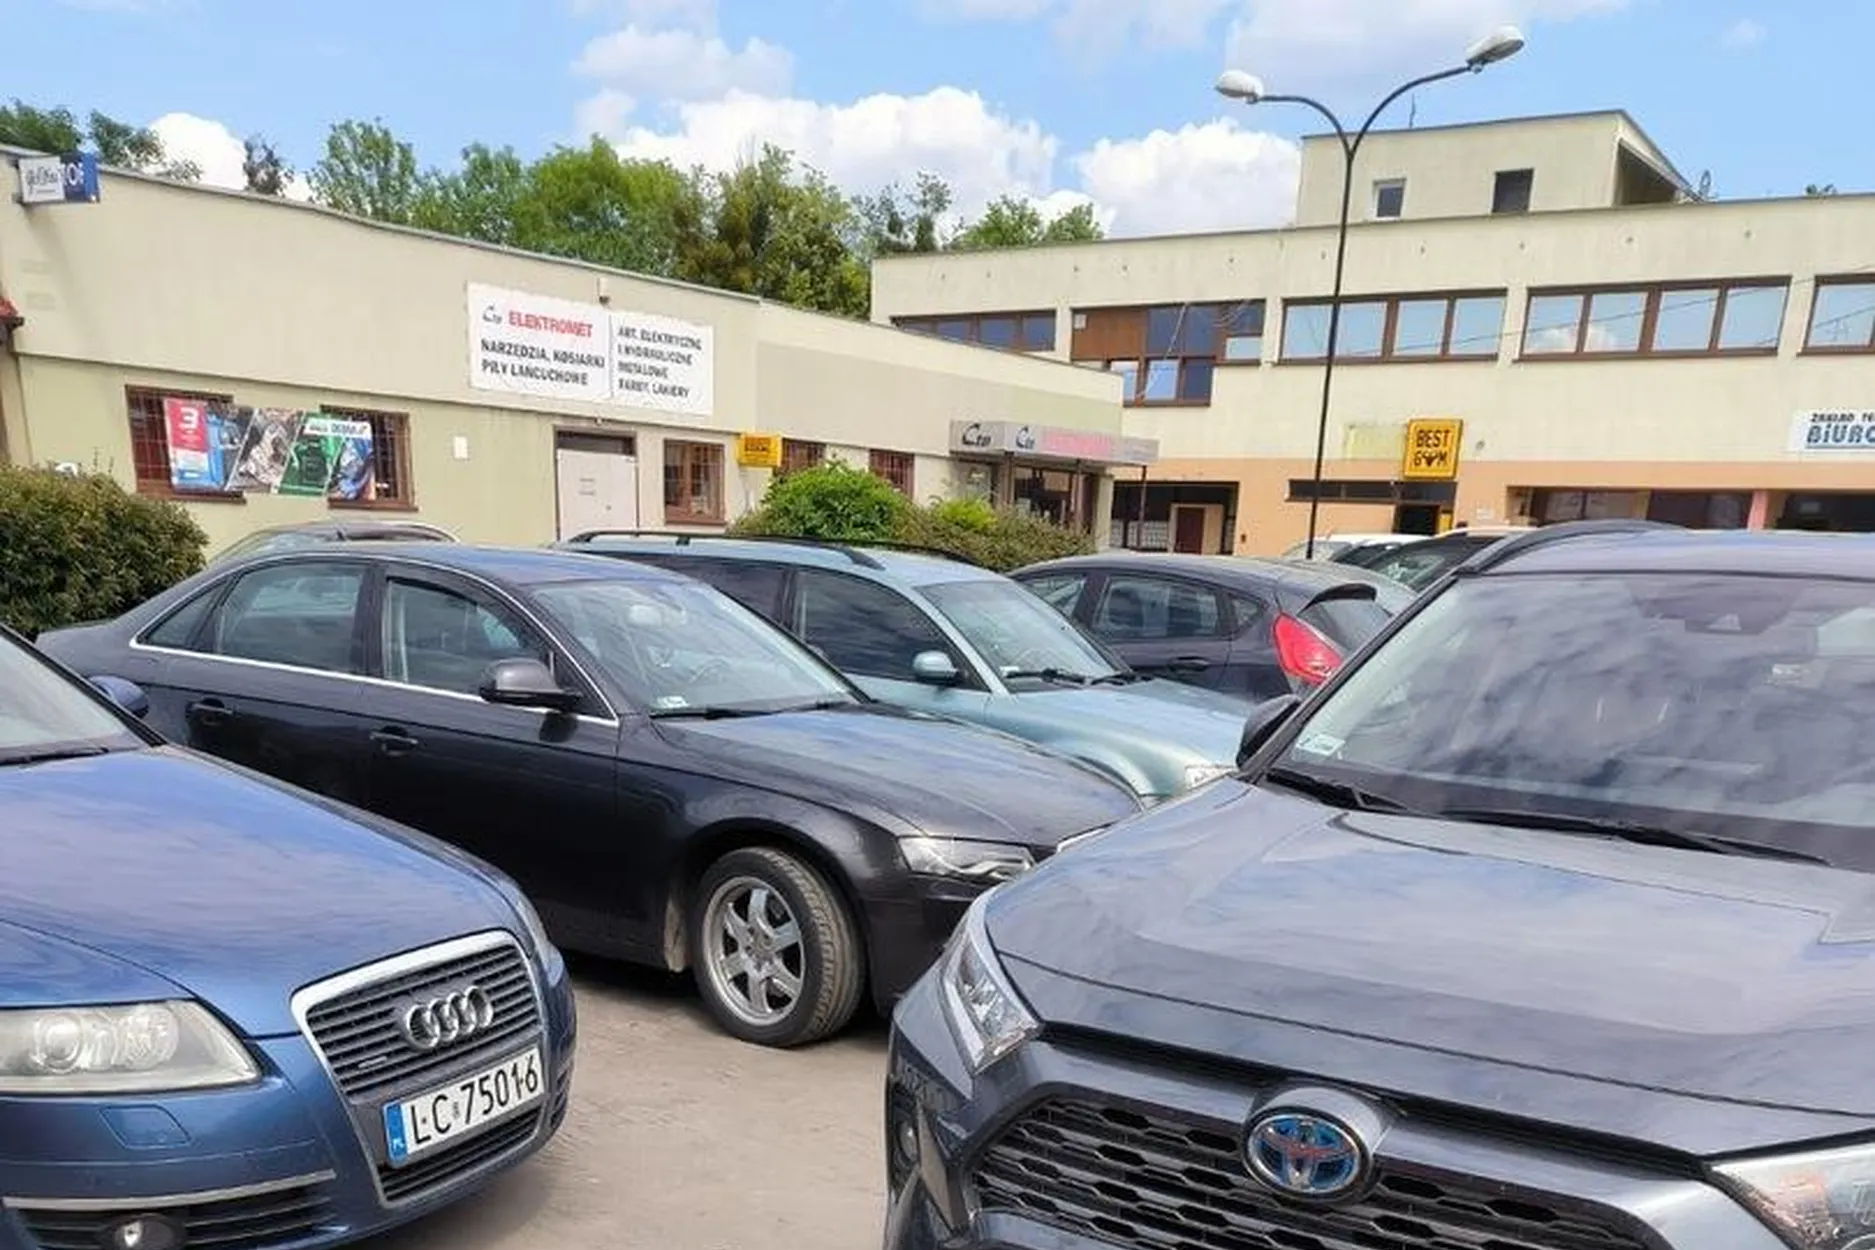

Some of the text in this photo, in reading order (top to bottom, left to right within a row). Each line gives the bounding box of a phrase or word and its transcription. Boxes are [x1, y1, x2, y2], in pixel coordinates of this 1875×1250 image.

[508, 309, 593, 338] ELEKTROMET
[553, 349, 606, 369] KOSIARKI
[1417, 428, 1452, 448] BEST
[1414, 450, 1448, 467] GYM
[410, 1056, 538, 1145] LC 75016
